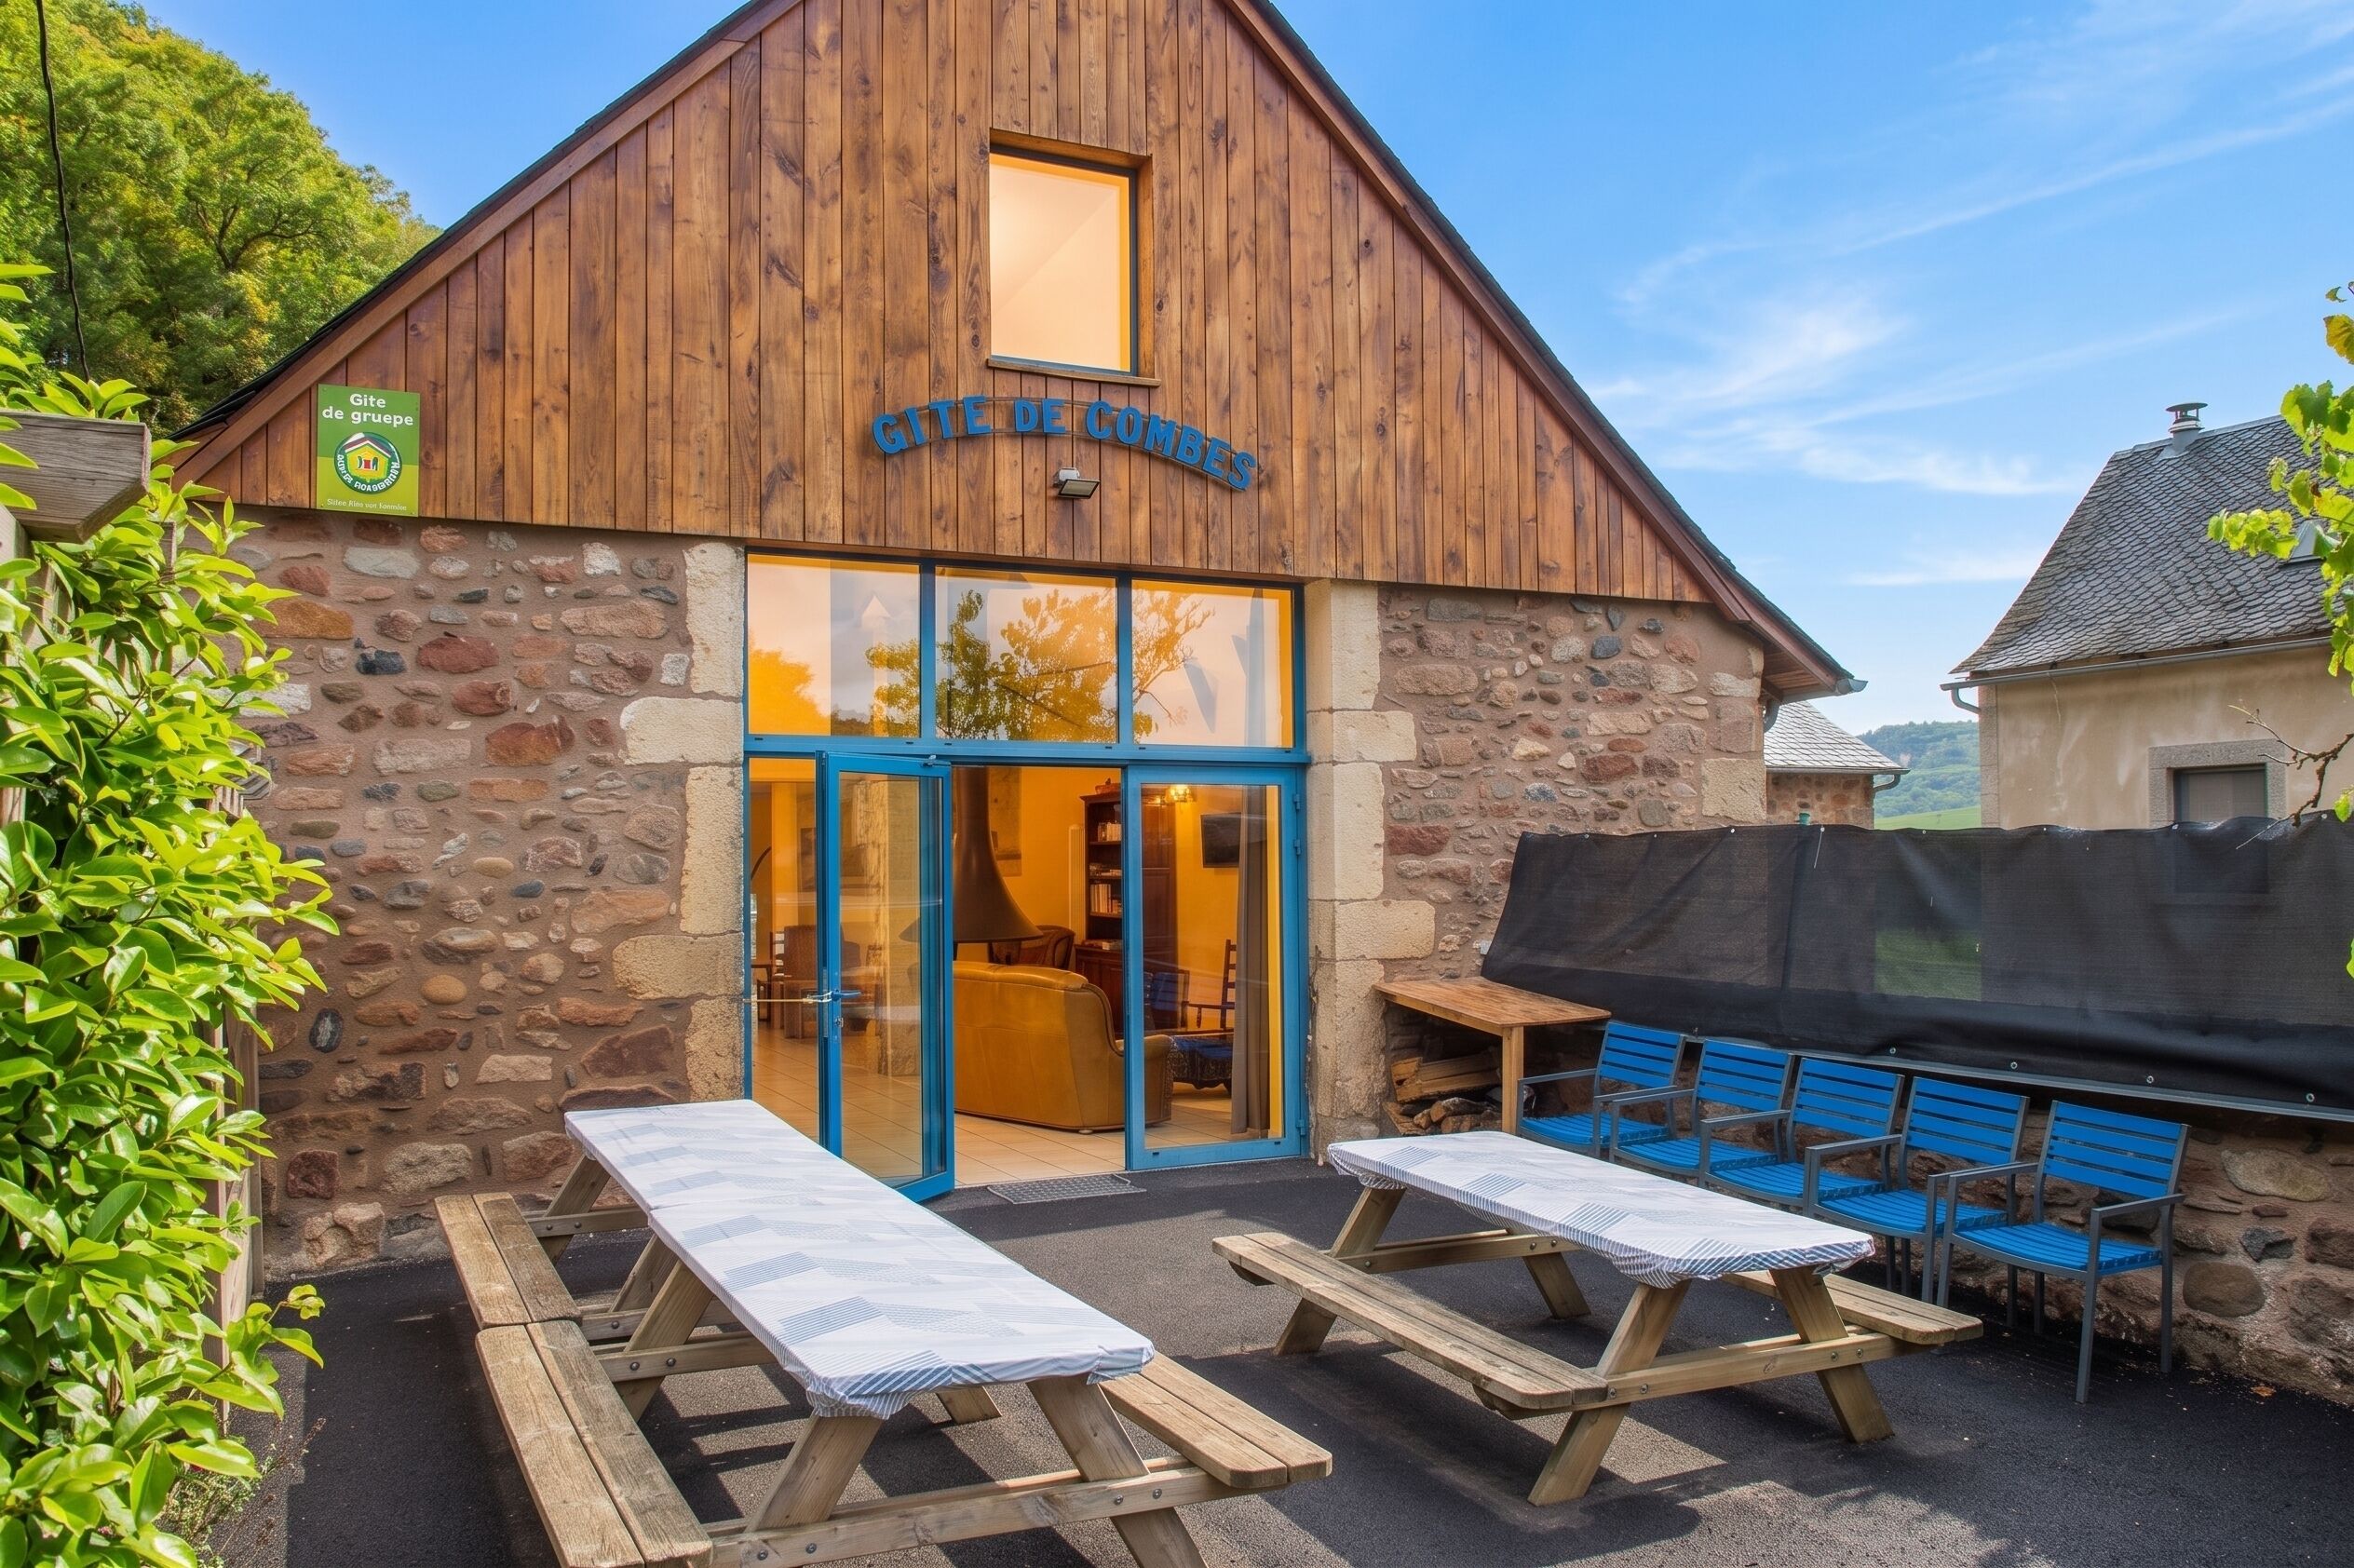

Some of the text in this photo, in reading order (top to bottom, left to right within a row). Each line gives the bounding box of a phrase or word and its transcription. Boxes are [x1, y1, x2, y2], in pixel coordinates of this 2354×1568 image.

[350, 394, 386, 408] Gite
[322, 406, 345, 420] de
[873, 395, 1257, 491] GITE DE COMBES
